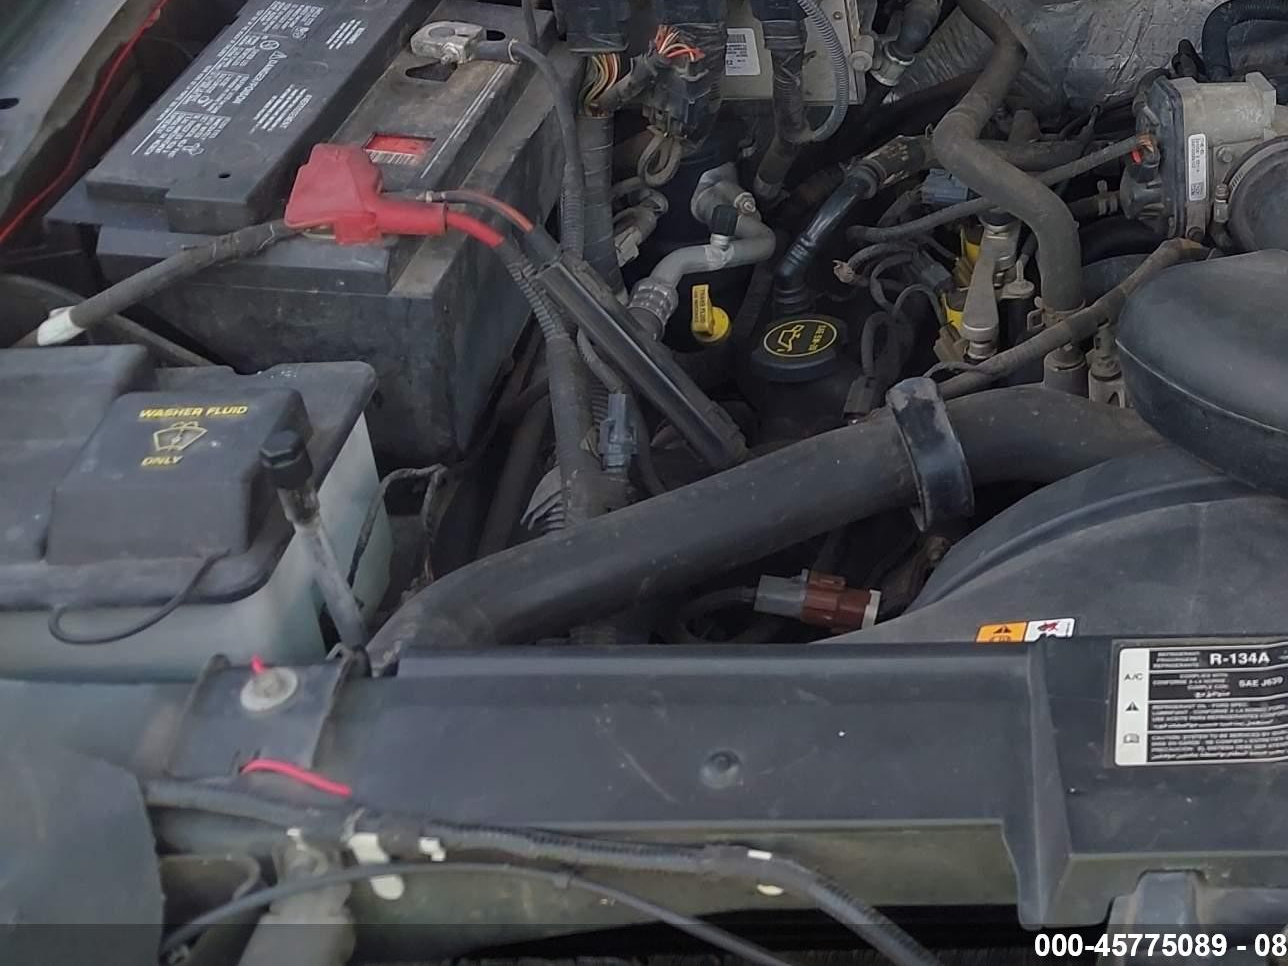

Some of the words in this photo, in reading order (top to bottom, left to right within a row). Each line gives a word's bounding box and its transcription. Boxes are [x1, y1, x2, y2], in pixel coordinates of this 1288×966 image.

[139, 407, 203, 418] WASHER
[205, 406, 249, 417] FLUID
[140, 455, 184, 467] ONLY
[1209, 653, 1271, 666] R-134A
[1124, 673, 1143, 681] A/C
[1238, 679, 1260, 688] SAE
